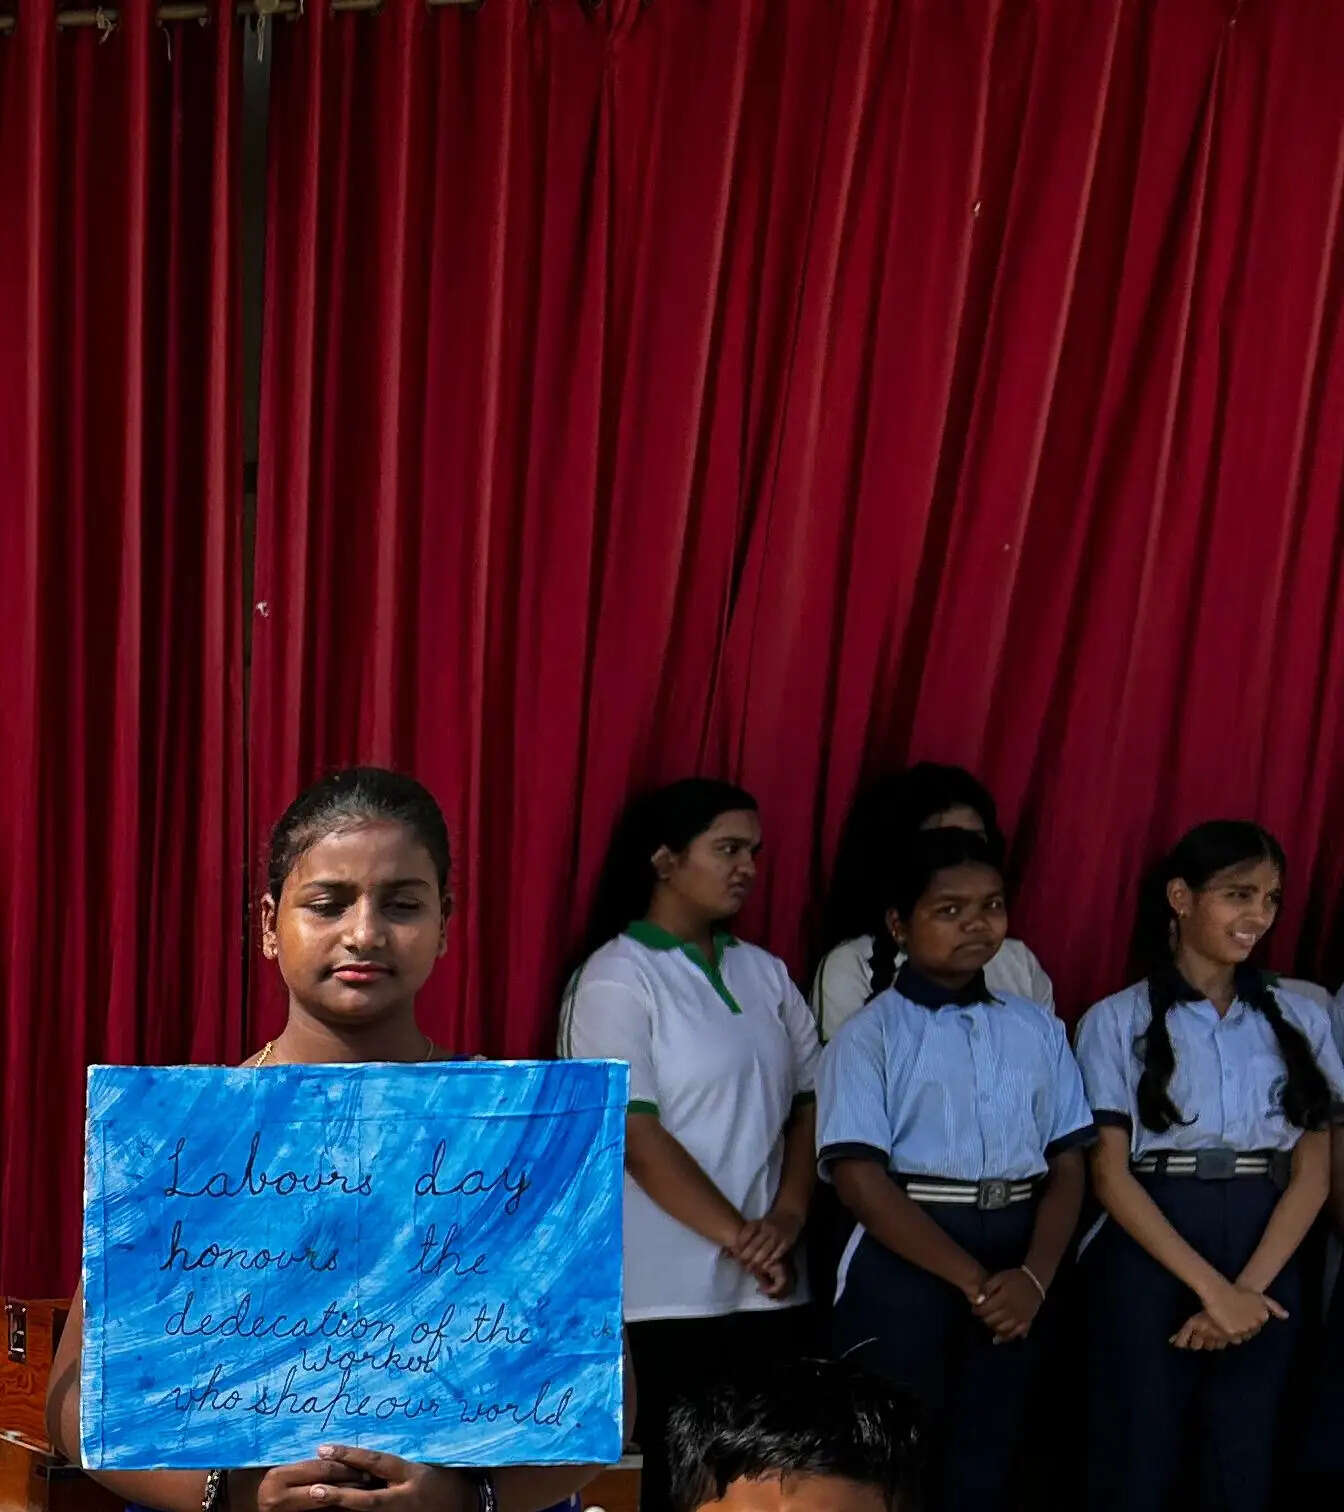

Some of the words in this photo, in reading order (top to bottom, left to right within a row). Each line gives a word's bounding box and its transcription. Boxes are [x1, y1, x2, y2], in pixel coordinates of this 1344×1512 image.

[163, 1131, 374, 1198] Labours
[415, 1138, 532, 1215] day
[160, 1220, 340, 1272] honours
[407, 1222, 488, 1276] the
[411, 1303, 450, 1361] of
[461, 1303, 532, 1345] the
[169, 1364, 243, 1413] who
[247, 1365, 368, 1432] shape
[375, 1398, 440, 1420] our
